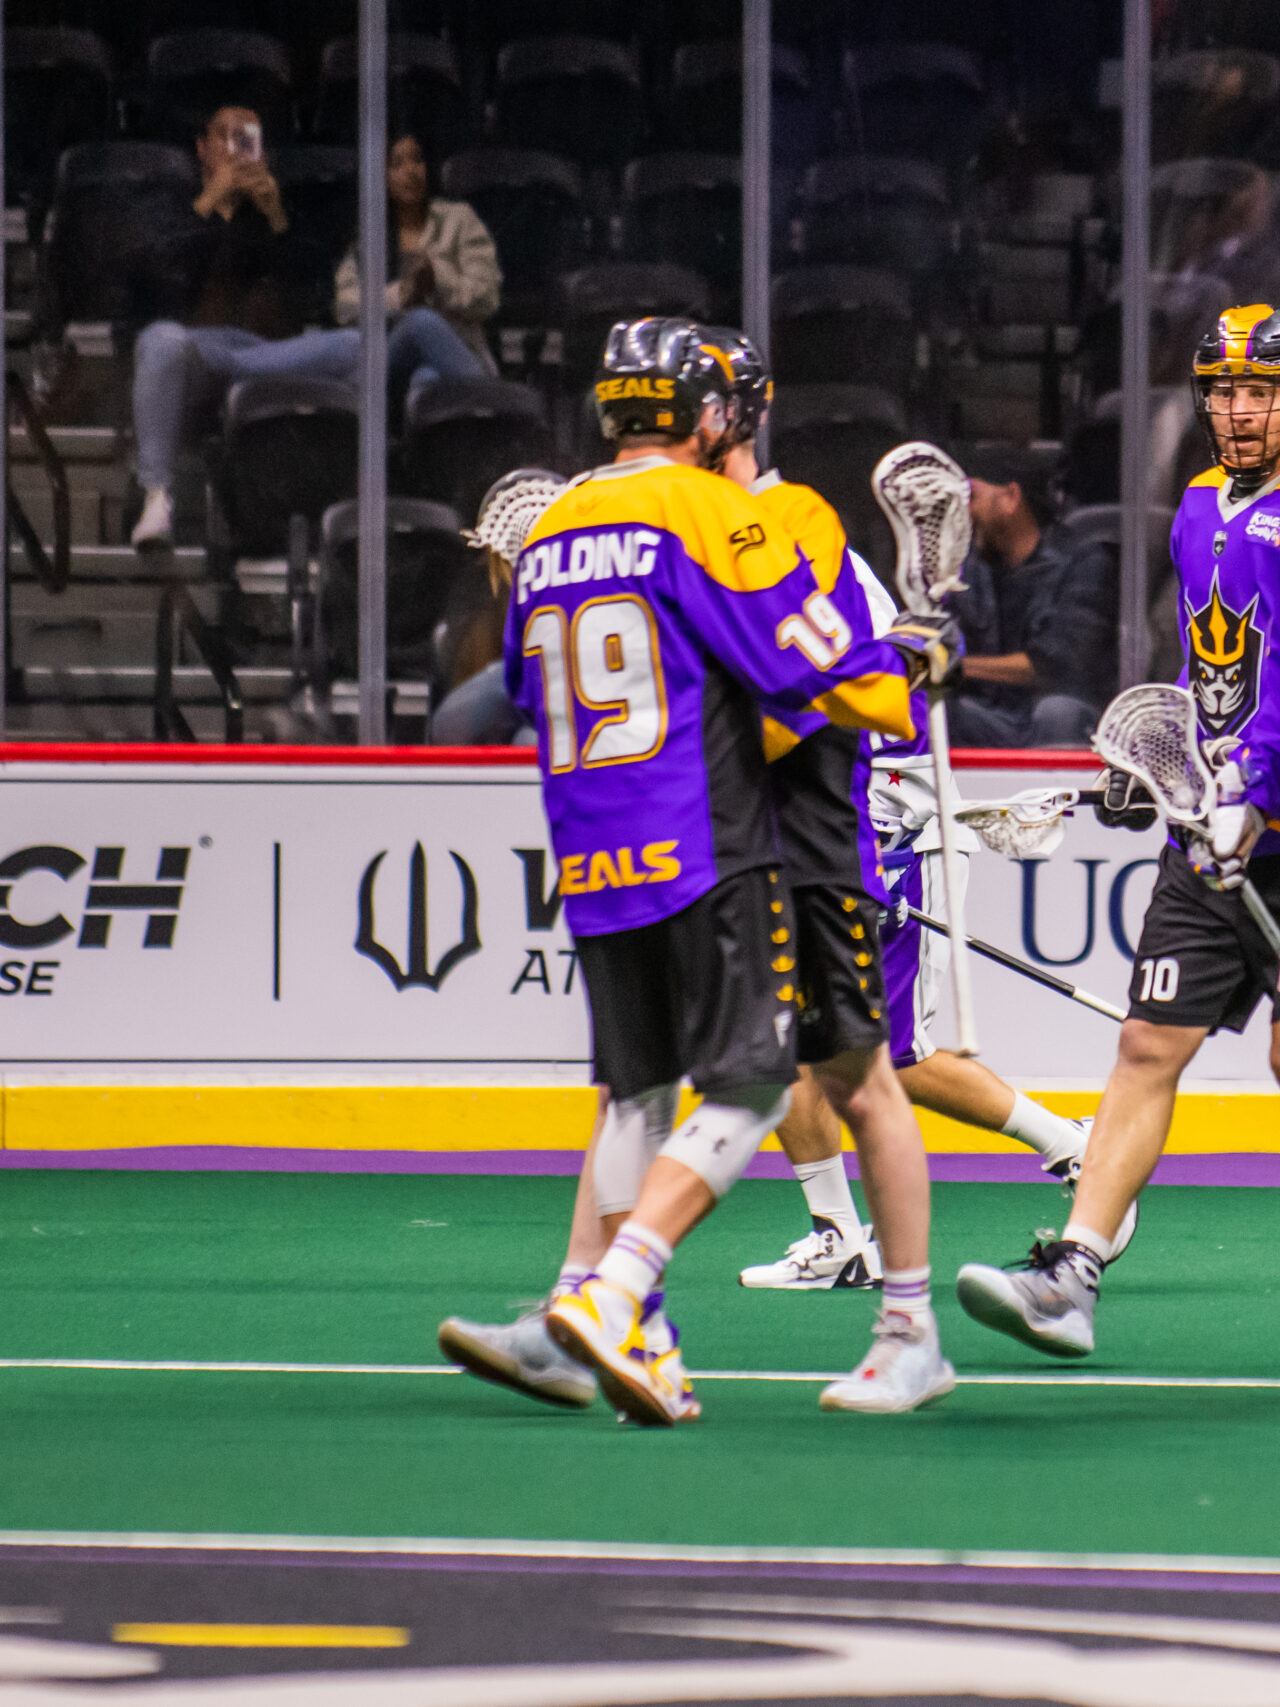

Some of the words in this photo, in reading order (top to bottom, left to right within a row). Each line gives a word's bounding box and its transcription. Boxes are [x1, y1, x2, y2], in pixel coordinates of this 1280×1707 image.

[595, 377, 676, 402] SEALS
[776, 590, 852, 672] 19
[523, 593, 668, 774] 19
[558, 840, 681, 895] EALS
[0, 960, 61, 996] SE
[1139, 956, 1180, 1002] 10
